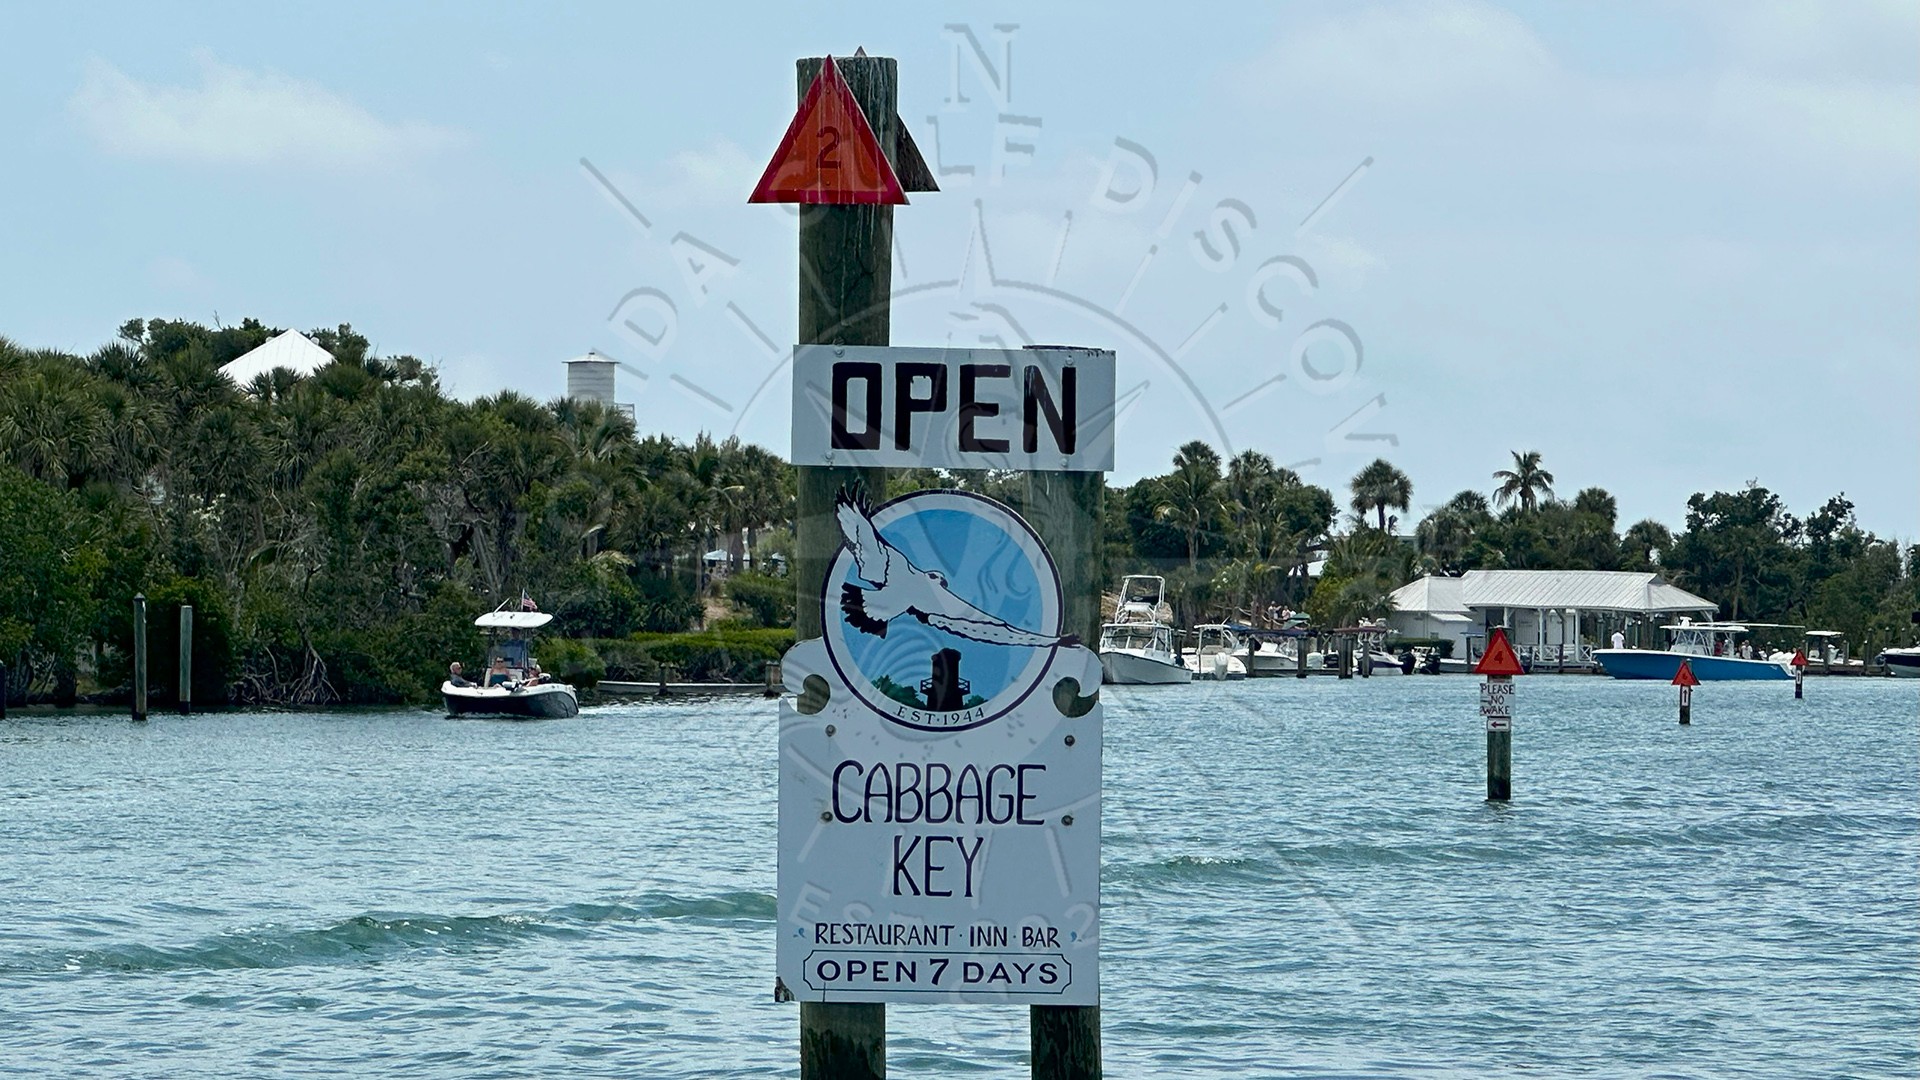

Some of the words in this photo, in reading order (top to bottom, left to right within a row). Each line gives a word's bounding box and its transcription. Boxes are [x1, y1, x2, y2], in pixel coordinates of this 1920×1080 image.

[816, 125, 841, 169] 2
[831, 362, 1077, 454] OPEN
[1494, 651, 1504, 665] 4
[1480, 683, 1514, 695] PLEASE
[1490, 695, 1504, 705] NO
[1480, 706, 1510, 715] WAKE
[832, 760, 1047, 825] CABBAGE
[892, 836, 984, 898] KEY
[814, 922, 955, 947] RESTAURANT
[969, 926, 1008, 947] INN
[1021, 927, 1061, 948] BAR
[816, 959, 917, 984] OPEN
[929, 958, 950, 986] 7
[962, 961, 1059, 985] DAYS
